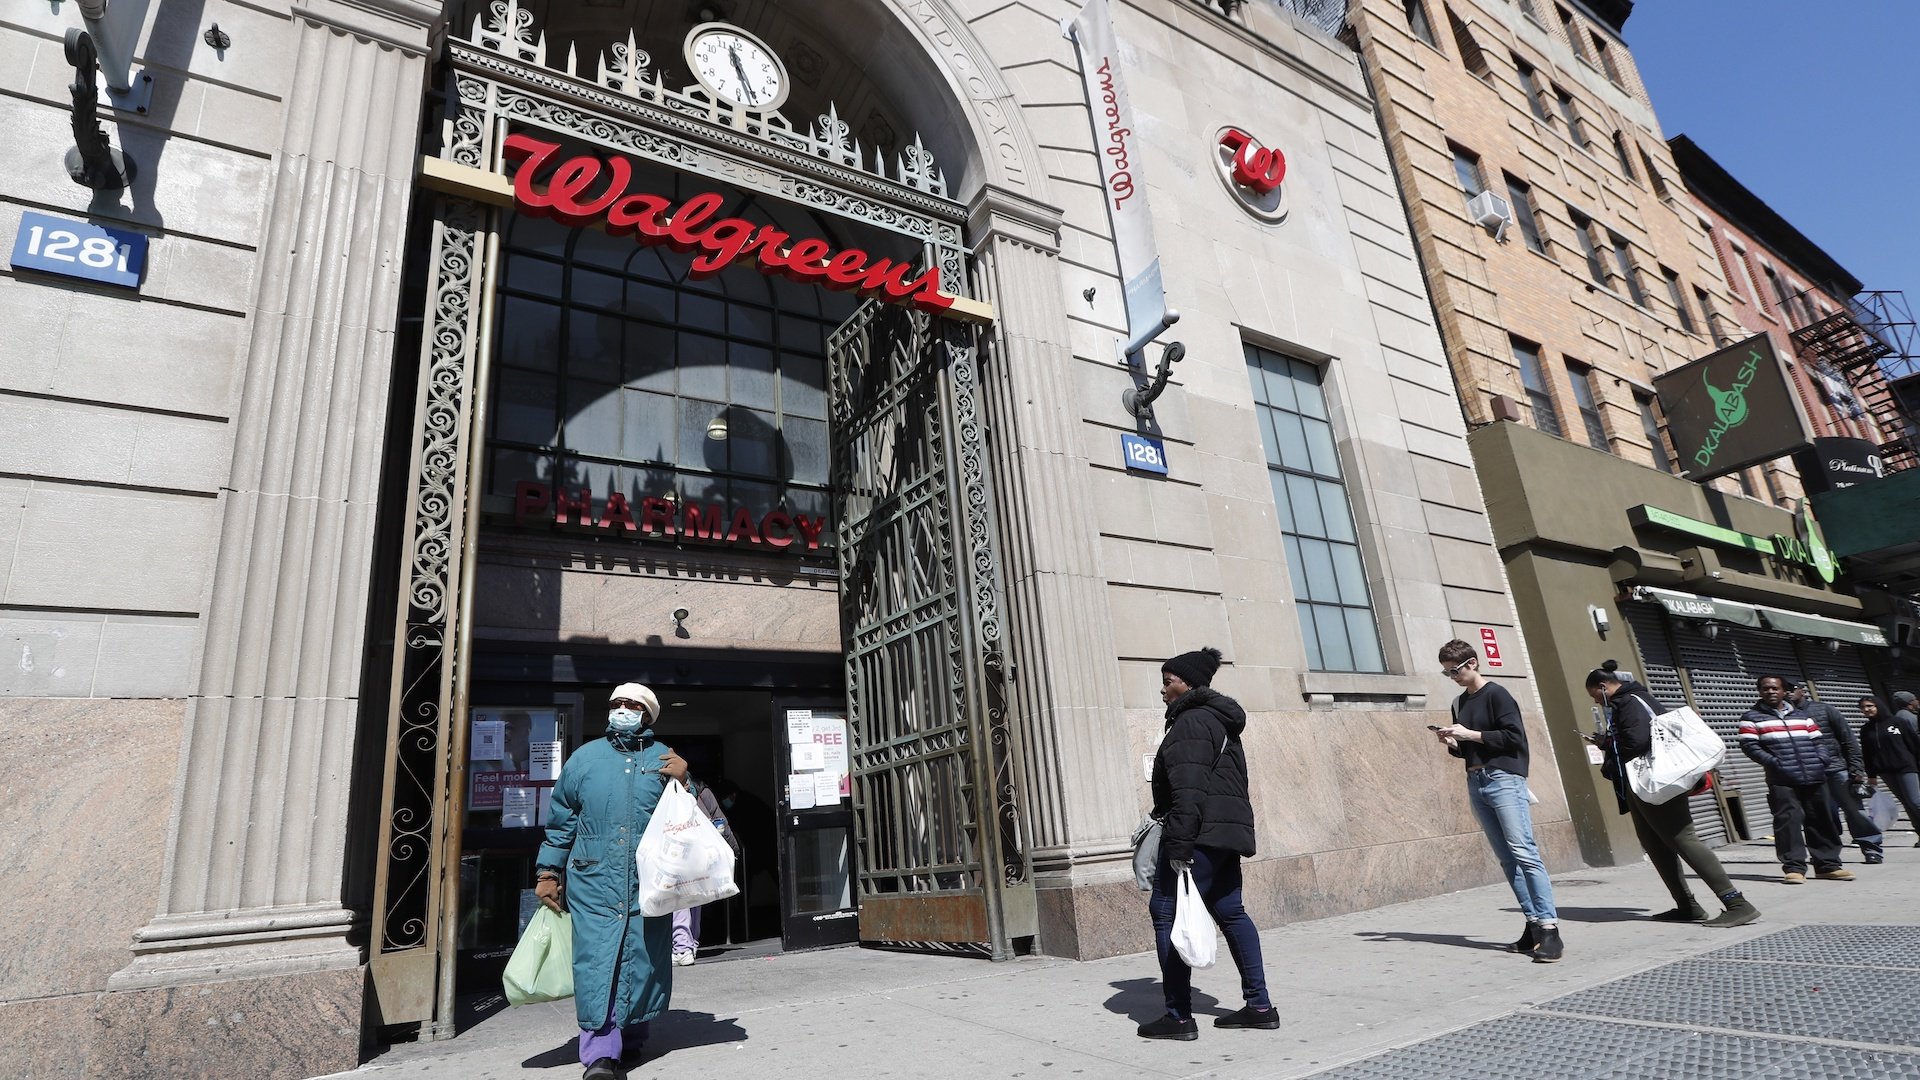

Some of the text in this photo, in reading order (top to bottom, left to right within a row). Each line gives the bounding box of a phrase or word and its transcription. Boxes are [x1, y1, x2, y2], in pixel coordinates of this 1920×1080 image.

[707, 44, 716, 54] 10
[717, 40, 726, 49] 11
[733, 41, 742, 51] 12
[702, 54, 708, 62] 9
[751, 51, 756, 59] 1
[761, 63, 768, 72] 2
[708, 68, 715, 77] 8
[719, 79, 725, 88] 7
[766, 76, 772, 85] 3
[736, 88, 742, 97] 6
[761, 86, 767, 94] 4
[1097, 57, 1134, 210] Walgreens
[706, 156, 771, 188] 1281
[503, 133, 954, 314] Walgreens
[27, 225, 131, 273] 1281
[1694, 350, 1762, 466] DKALABASH
[1127, 441, 1163, 466] 1281
[515, 481, 826, 549] PHARMACY
[813, 733, 842, 745] REE
[474, 773, 500, 782] Feel
[474, 784, 496, 792] like
